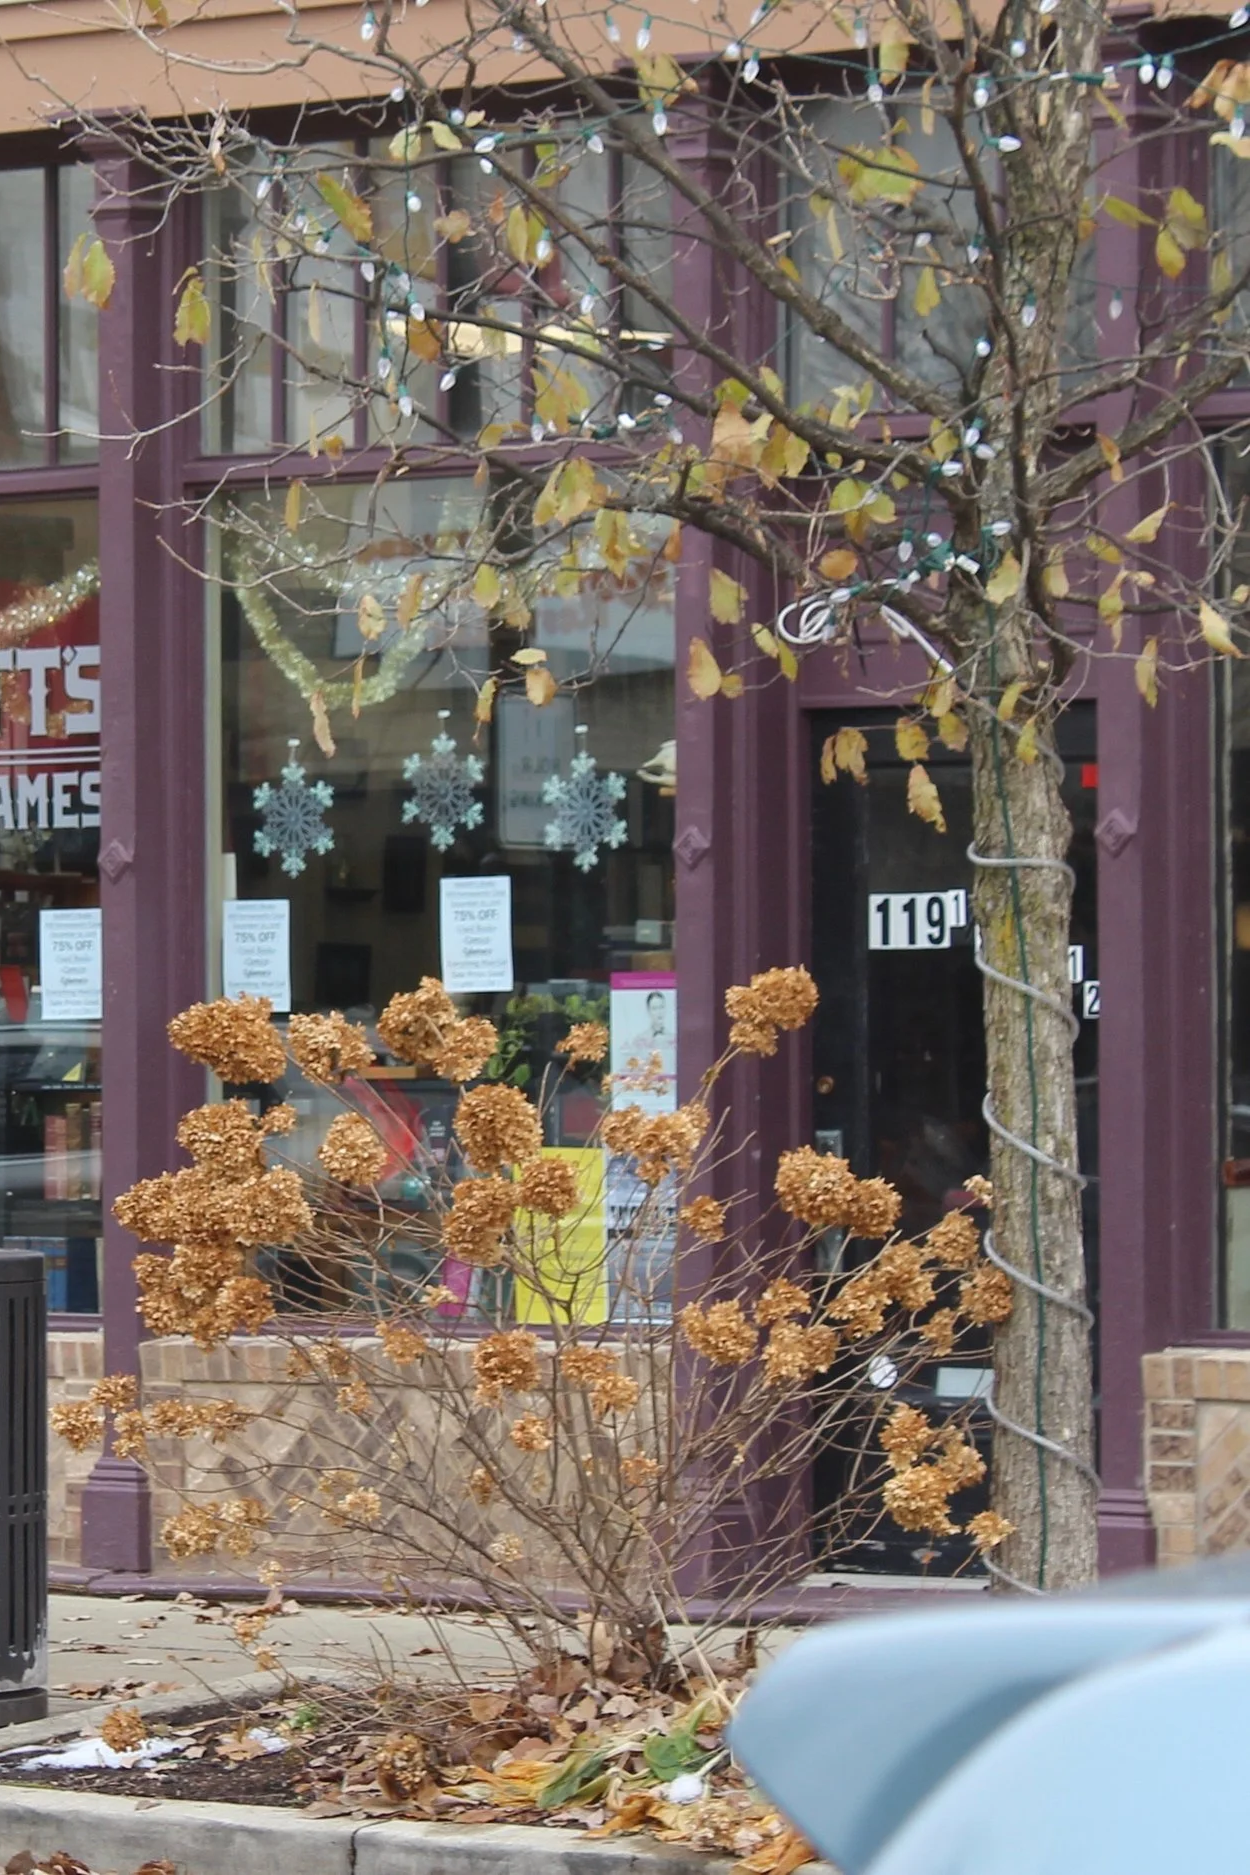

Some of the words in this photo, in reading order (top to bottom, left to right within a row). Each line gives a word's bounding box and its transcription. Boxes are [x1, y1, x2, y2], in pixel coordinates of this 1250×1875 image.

[453, 909, 476, 922] 75%
[876, 896, 946, 946] 119
[235, 931, 256, 944] 75%
[52, 940, 74, 952] 75%
